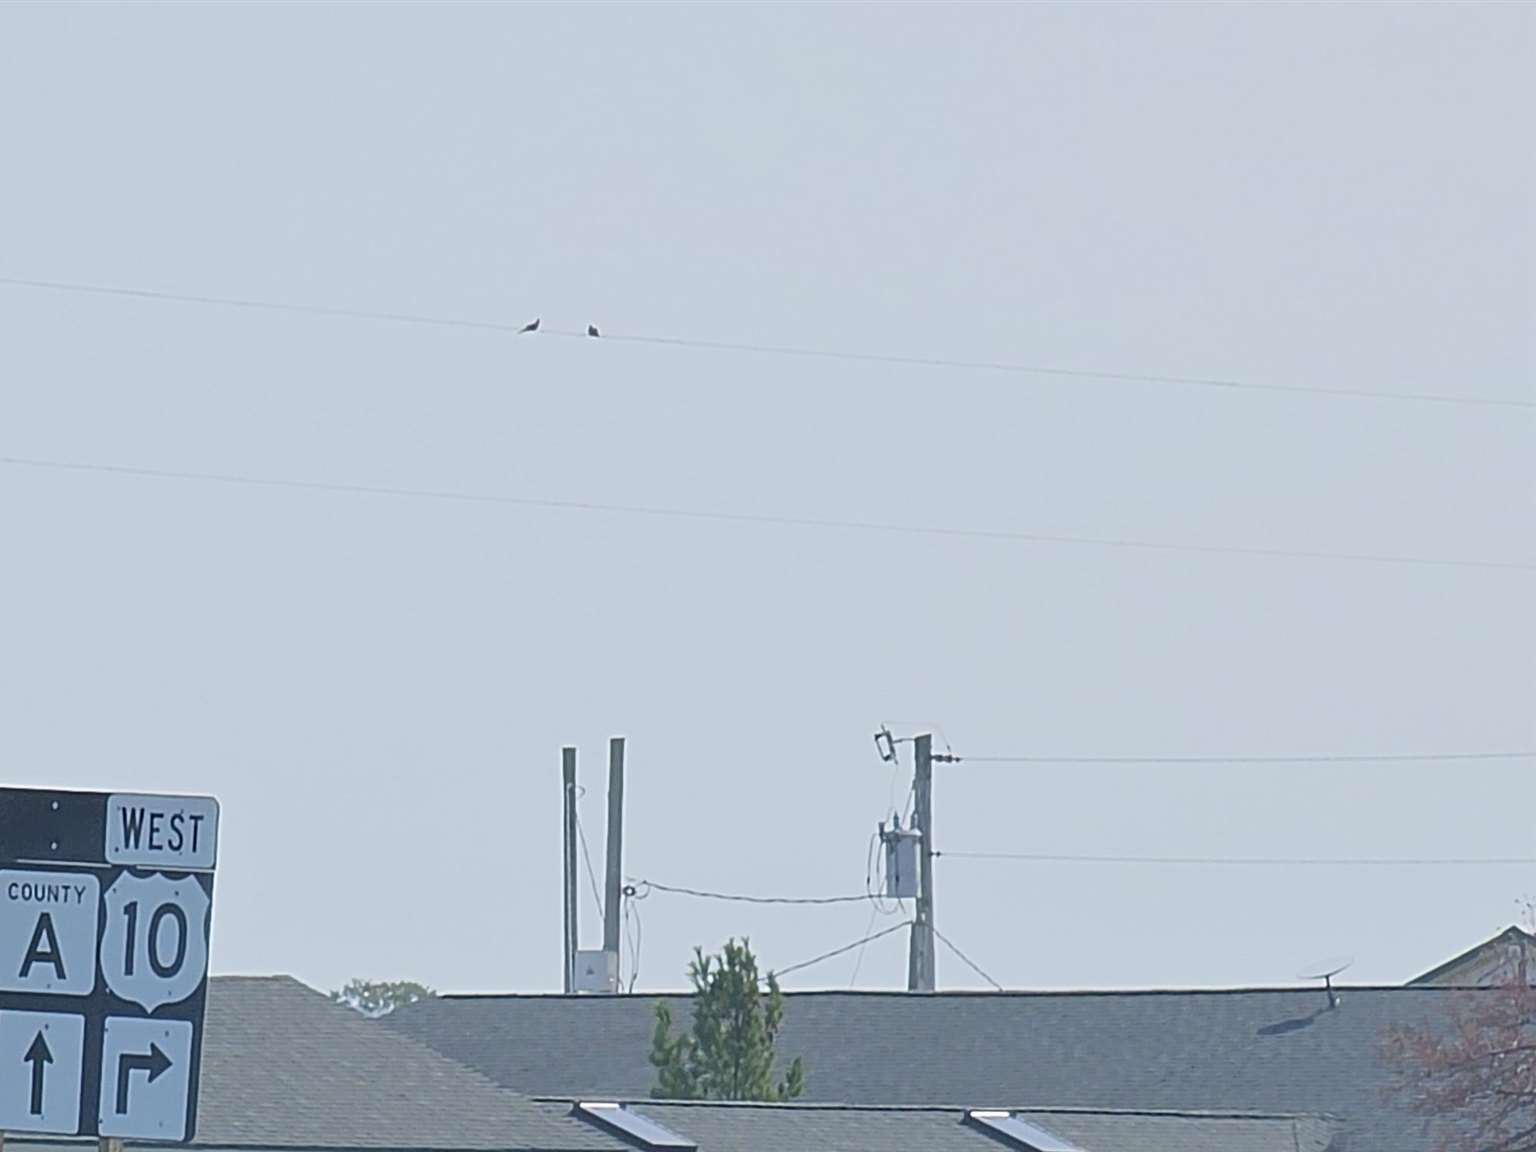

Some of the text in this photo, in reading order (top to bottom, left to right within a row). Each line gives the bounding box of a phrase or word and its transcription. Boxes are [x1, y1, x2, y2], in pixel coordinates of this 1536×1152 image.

[121, 806, 205, 854] WEST
[7, 881, 88, 905] COUNTY
[18, 912, 68, 981] A
[122, 900, 188, 979] 10
